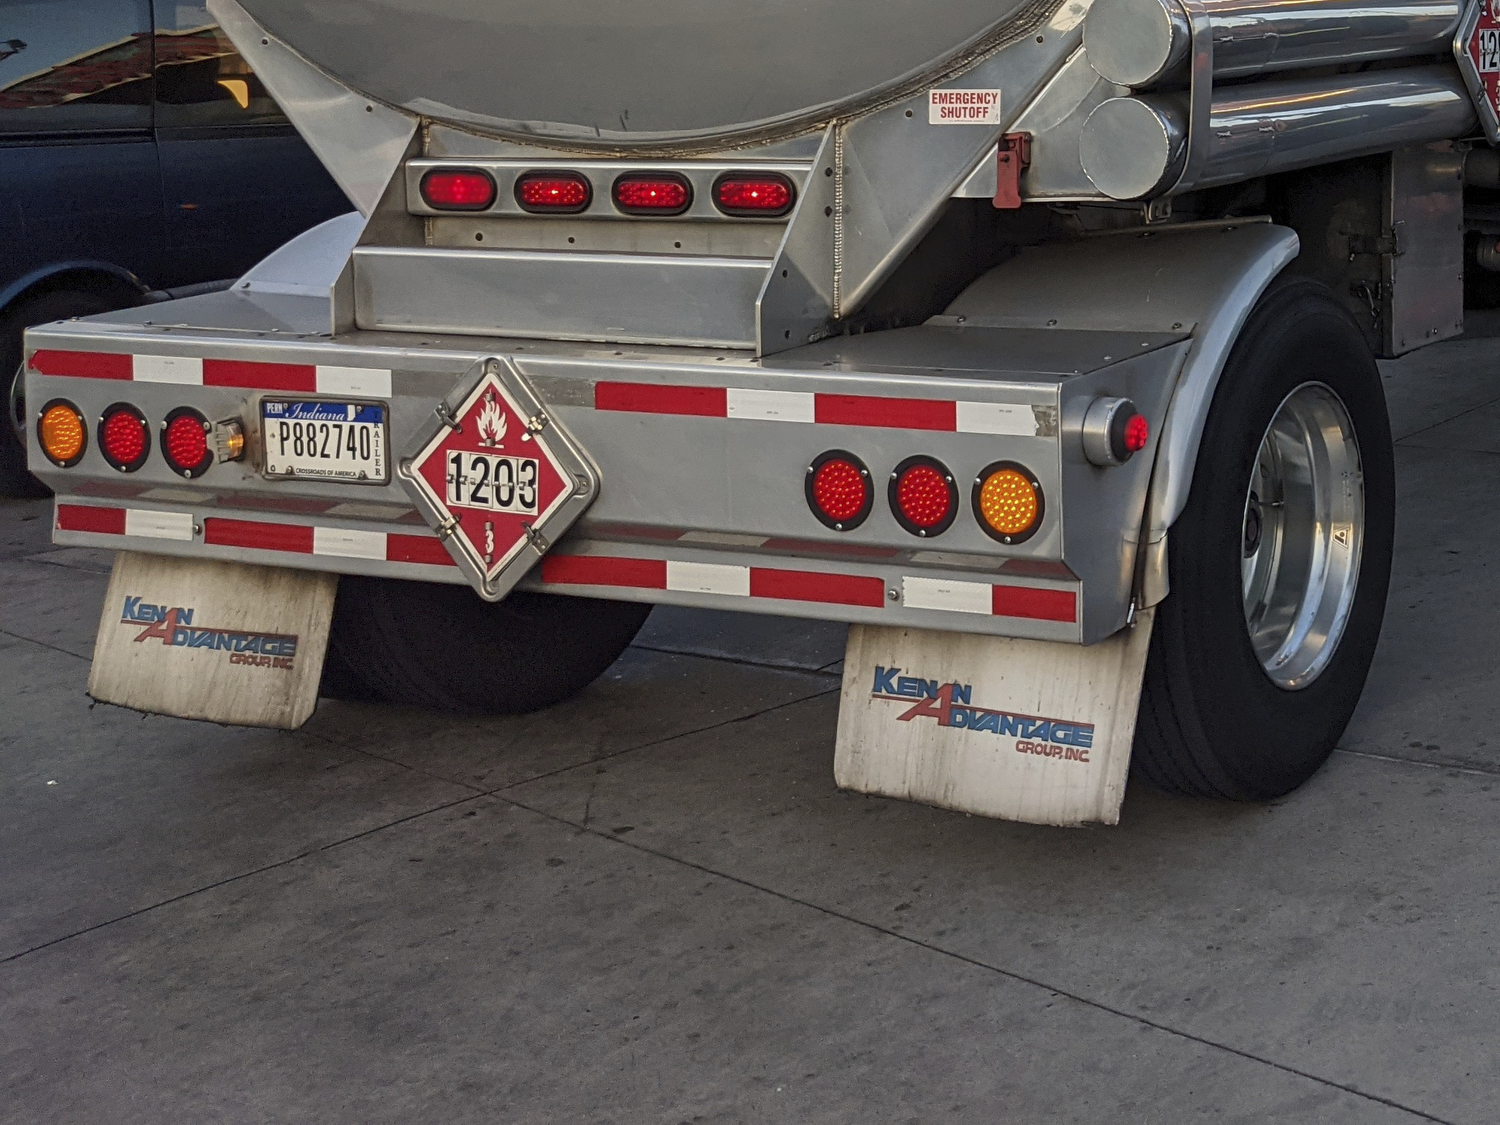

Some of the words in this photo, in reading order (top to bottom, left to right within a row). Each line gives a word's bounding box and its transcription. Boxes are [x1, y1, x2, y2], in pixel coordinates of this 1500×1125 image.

[932, 93, 998, 104] EMERGENCY
[940, 107, 989, 118] SHUTOFF
[266, 402, 284, 414] PERM
[285, 402, 346, 421] Indiana
[280, 421, 371, 461] P882740
[373, 410, 383, 476] TRAILER
[295, 467, 327, 475] CROSSROADS
[334, 469, 357, 477] AMERICA
[450, 452, 537, 509] 1203
[485, 530, 494, 554] 3
[122, 595, 194, 625] KENAN
[133, 608, 298, 657] ADVANTAGE
[872, 665, 972, 705] KENAN
[896, 683, 1095, 748] ADVANTAGE
[1015, 739, 1064, 759] GROUP,
